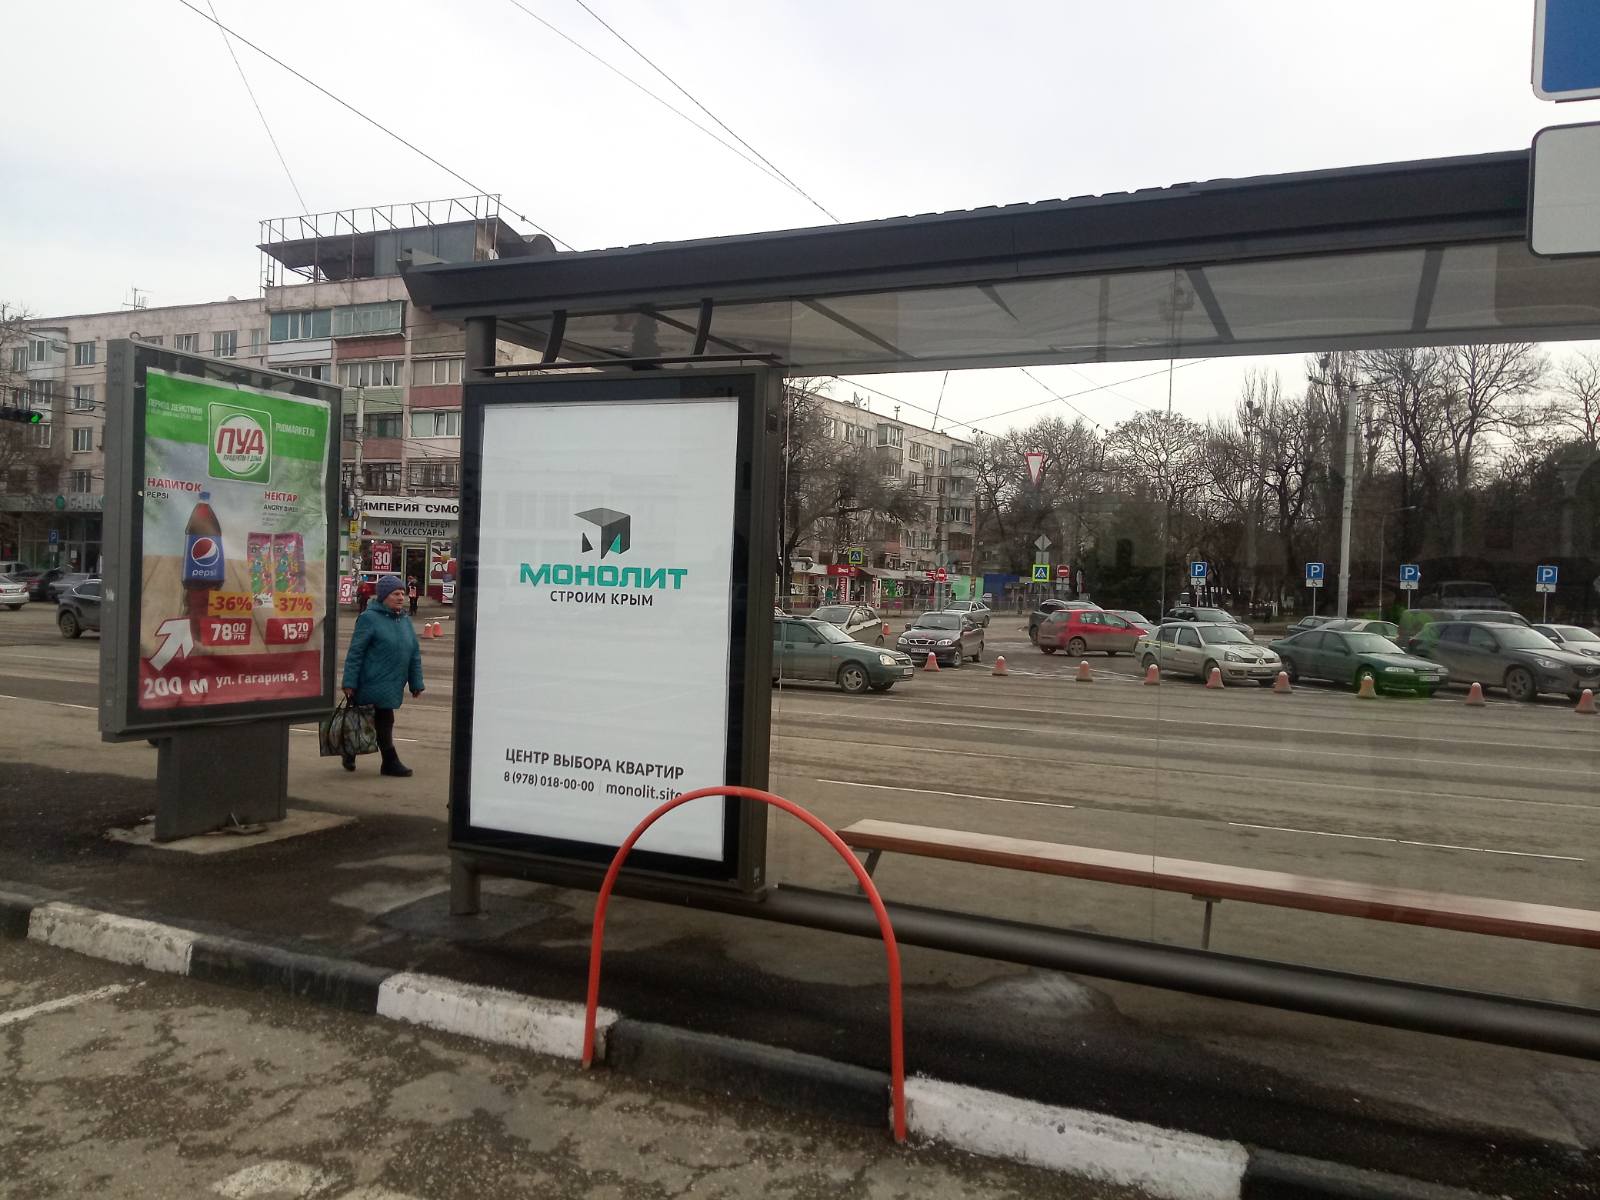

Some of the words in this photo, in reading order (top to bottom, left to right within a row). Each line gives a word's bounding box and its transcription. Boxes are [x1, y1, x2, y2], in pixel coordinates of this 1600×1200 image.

[216, 428, 265, 454] ПУД
[147, 478, 202, 492] НАПИТОК
[146, 491, 169, 499] PEPSI
[264, 491, 298, 502] НЕКТАР
[362, 502, 419, 512] ИМПЕРИЯ
[391, 528, 445, 536] АКСЕССУАРЫ
[191, 569, 217, 577] pepsi
[520, 563, 688, 589] МОНОЛИТ
[209, 595, 252, 611] -36%
[275, 597, 313, 612] -37%
[550, 590, 606, 605] СТРОИМ
[611, 593, 653, 606] КРЫМ
[143, 676, 183, 699] 200
[216, 675, 235, 689] ул.
[238, 672, 299, 686] Гагарина,
[301, 670, 309, 681] 3
[505, 748, 550, 765] ЦЕНТР
[553, 753, 612, 772] ВЫБОРА
[615, 760, 684, 780] КВАРТИР
[503, 771, 510, 782] 8
[512, 772, 538, 787] (978)
[540, 775, 595, 792] 018-00-00
